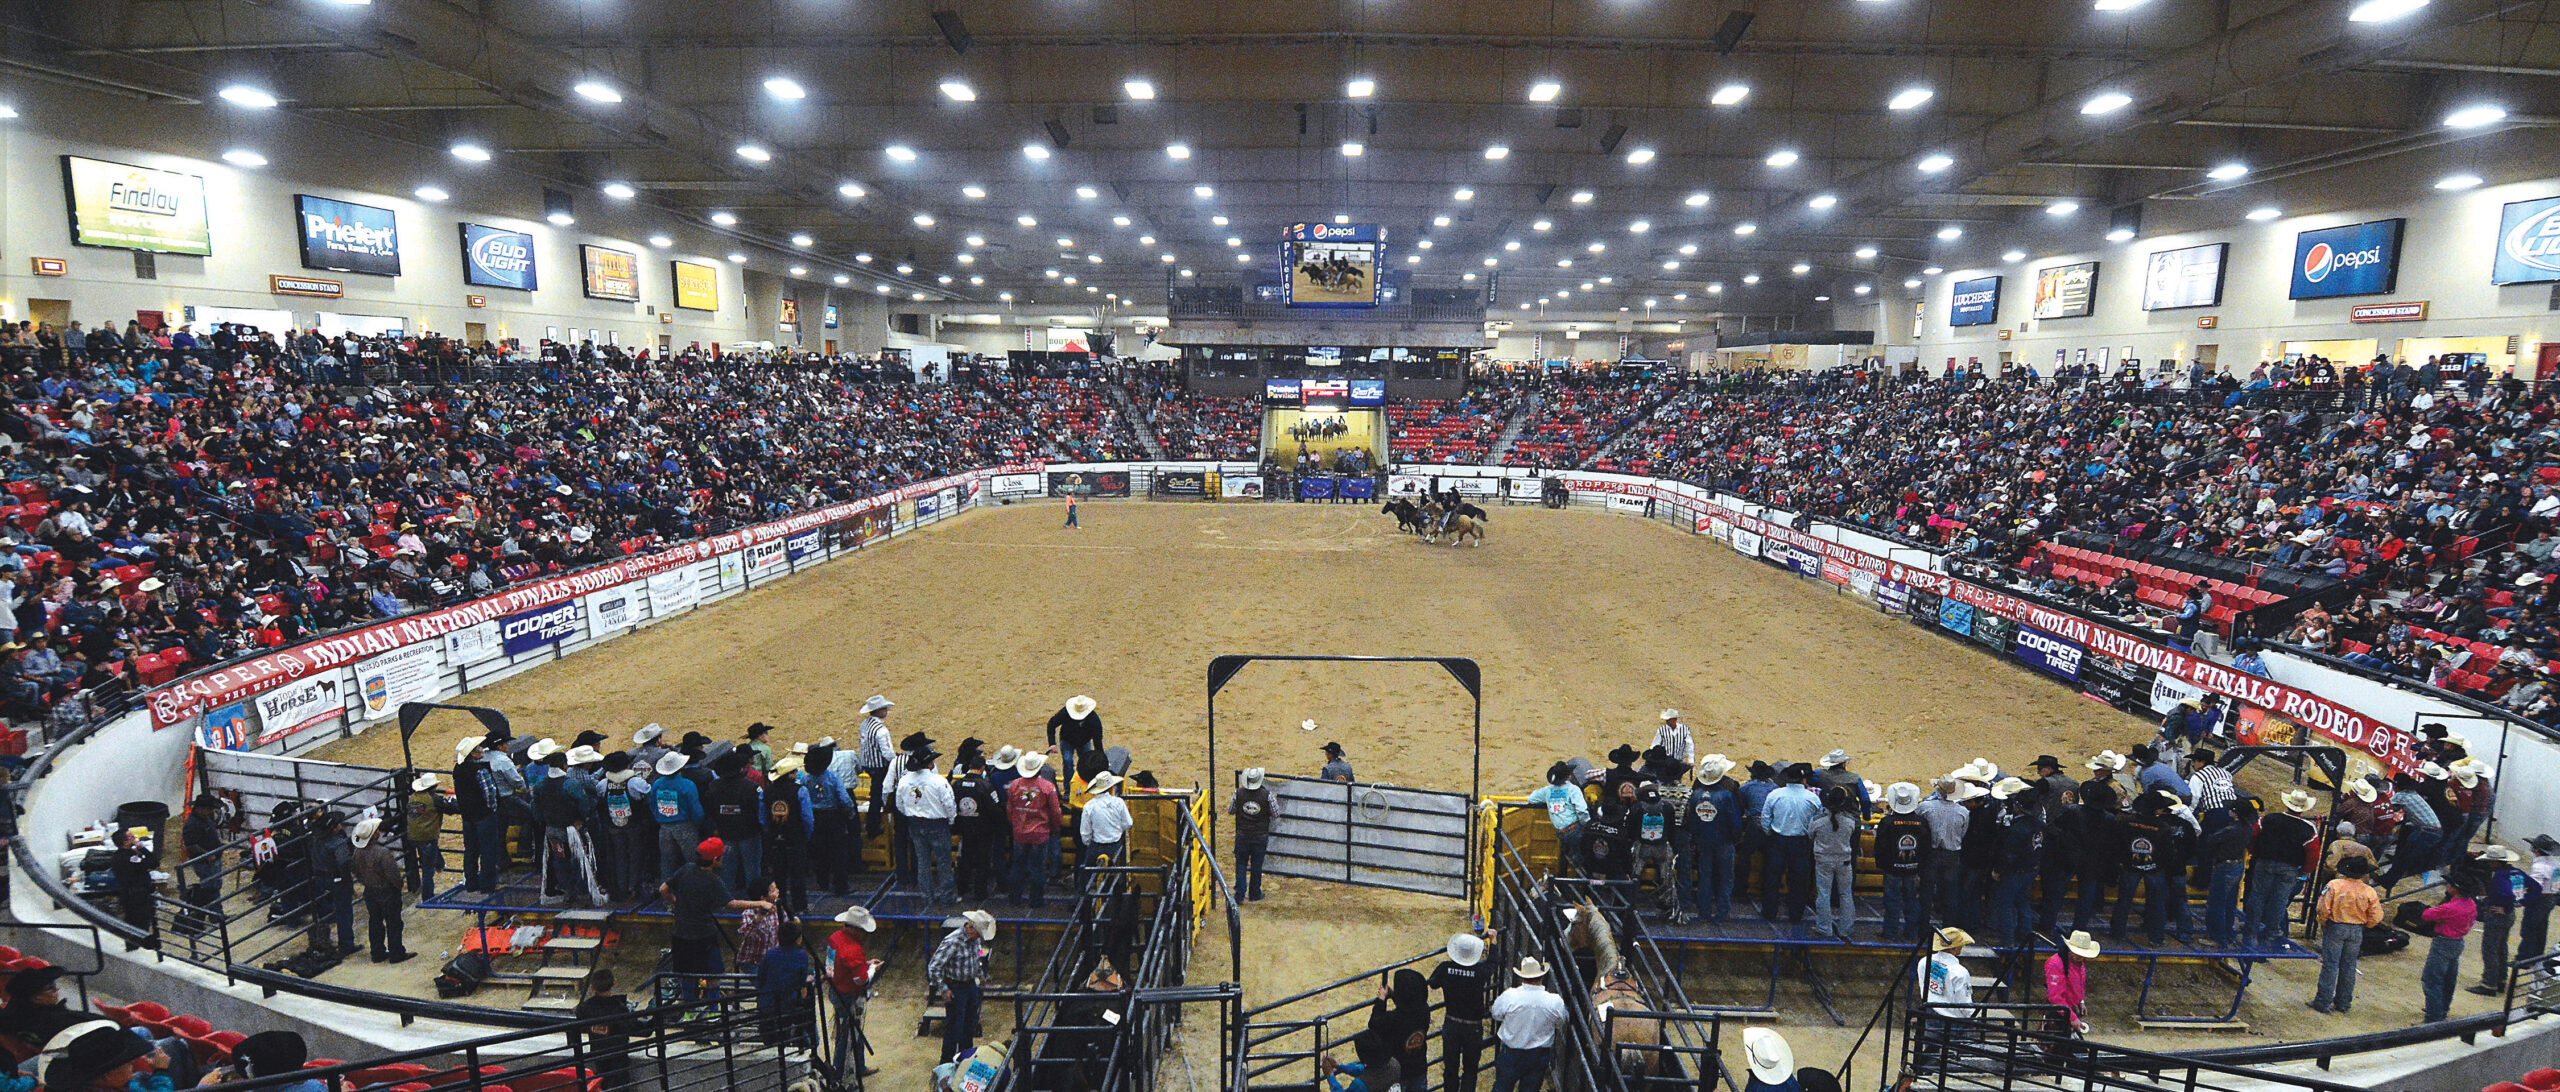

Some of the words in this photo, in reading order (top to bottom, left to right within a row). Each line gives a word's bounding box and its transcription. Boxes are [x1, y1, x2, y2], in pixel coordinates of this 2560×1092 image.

[110, 182, 179, 213] Findlay
[307, 214, 394, 248] Priefert
[1328, 227, 1355, 237] pepsi
[489, 241, 527, 258] BUD
[2333, 246, 2380, 271] pepsi
[481, 252, 530, 272] LIGHT
[279, 280, 318, 292] CONCESSION
[320, 283, 340, 293] STAND
[680, 277, 714, 290] STETSON
[1954, 290, 1994, 306] LUCCHESE
[2355, 307, 2395, 318] CONCESSION
[2396, 306, 2420, 315] STAND
[2440, 364, 2462, 372] 118
[1454, 479, 1482, 490] Classic
[1576, 480, 1617, 489] ROPER
[1619, 498, 1643, 506] RAM
[754, 522, 788, 541] INDIAN
[786, 511, 825, 533] NATIONAL
[757, 541, 782, 558] RAM
[788, 532, 819, 550] COOPER
[1768, 524, 1790, 542] INDIAN
[1790, 529, 1824, 554] NATIONAL
[1826, 544, 1856, 568] FINALS
[1857, 553, 1887, 575] RODEO
[637, 548, 685, 568] ROPER
[1788, 548, 1818, 567] COOPER
[1965, 585, 2015, 612] ROPER
[303, 626, 400, 669] INDIAN
[398, 597, 508, 643] NATIONAL
[507, 579, 571, 611] FINALS
[573, 566, 623, 594] RODEO
[505, 605, 576, 640] COOPER
[540, 619, 577, 640] TIRES
[2017, 630, 2082, 664] COOPER
[358, 660, 380, 673] NAVAJO
[380, 654, 398, 667] PARKS
[403, 645, 434, 659] RECREATION
[2045, 653, 2078, 675] TIRES
[173, 659, 280, 704] ROPER
[2030, 608, 2089, 644] INDIAN
[2091, 627, 2187, 677] NATIONAL
[2193, 662, 2280, 709] FINALS
[2281, 691, 2363, 743] RODEO
[182, 697, 218, 717] WER
[225, 687, 246, 702] THE
[254, 675, 284, 692] WEST
[2268, 718, 2296, 736] GOOD
